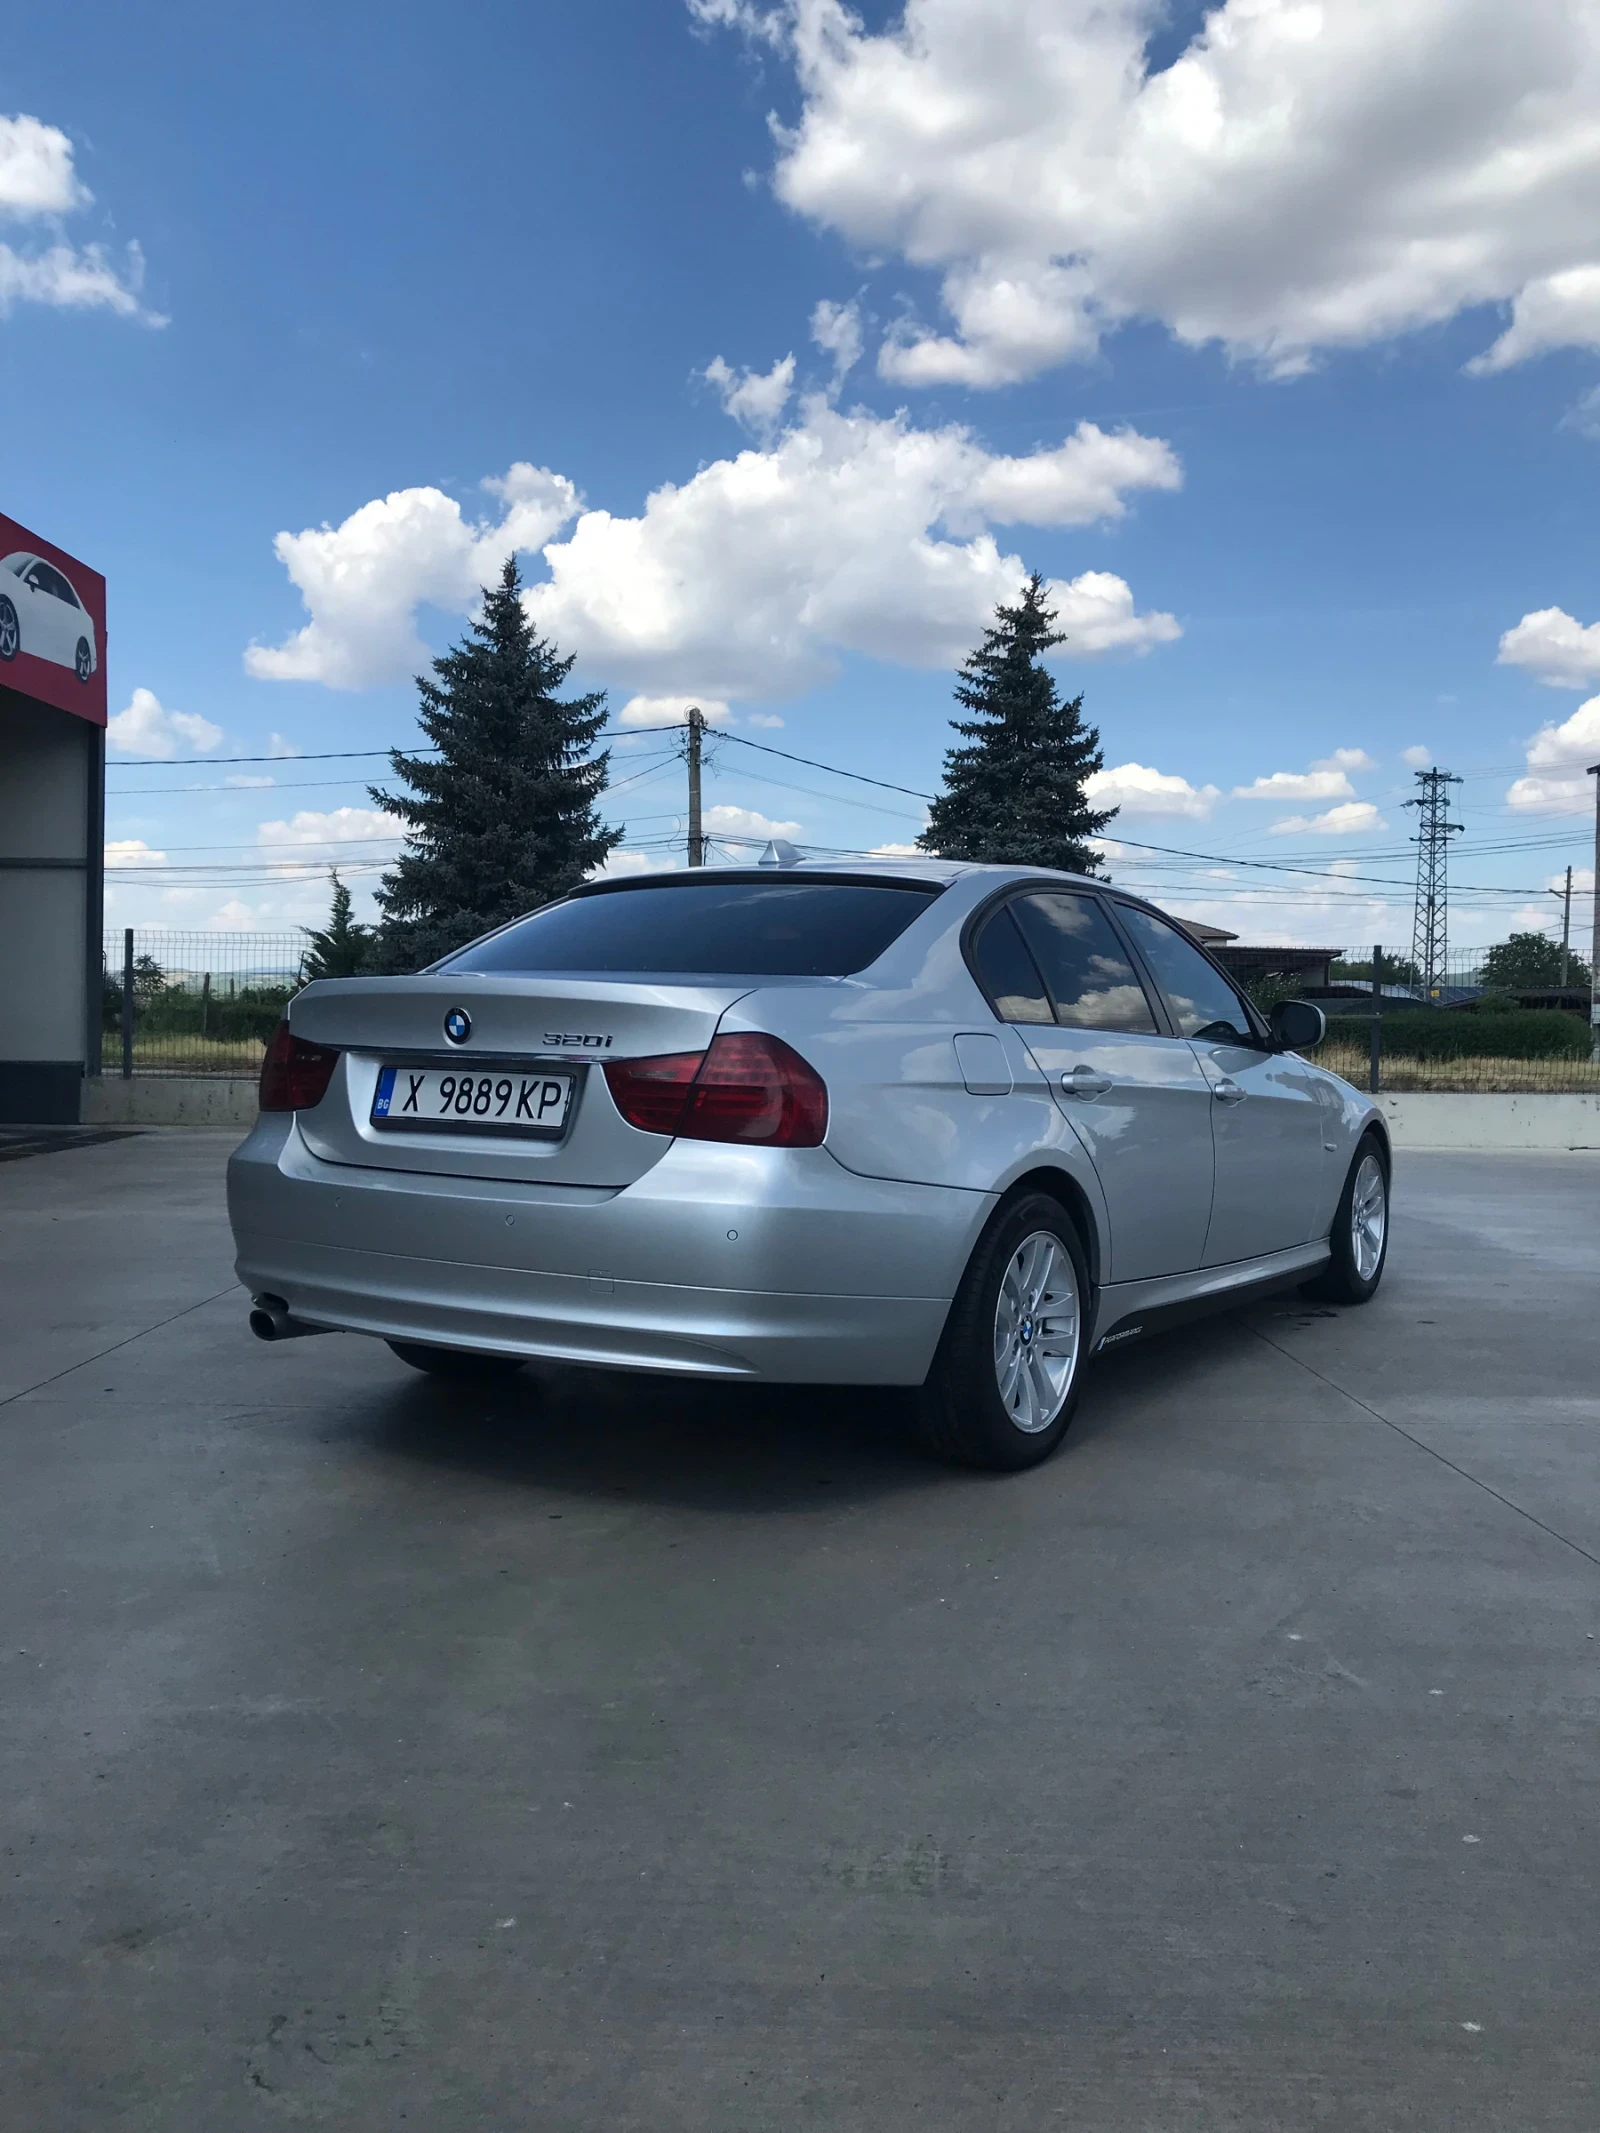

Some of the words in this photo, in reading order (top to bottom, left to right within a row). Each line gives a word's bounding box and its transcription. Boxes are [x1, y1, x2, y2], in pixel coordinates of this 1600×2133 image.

[543, 1032, 613, 1048] 320i
[402, 1074, 426, 1112] X
[376, 1098, 390, 1110] BG
